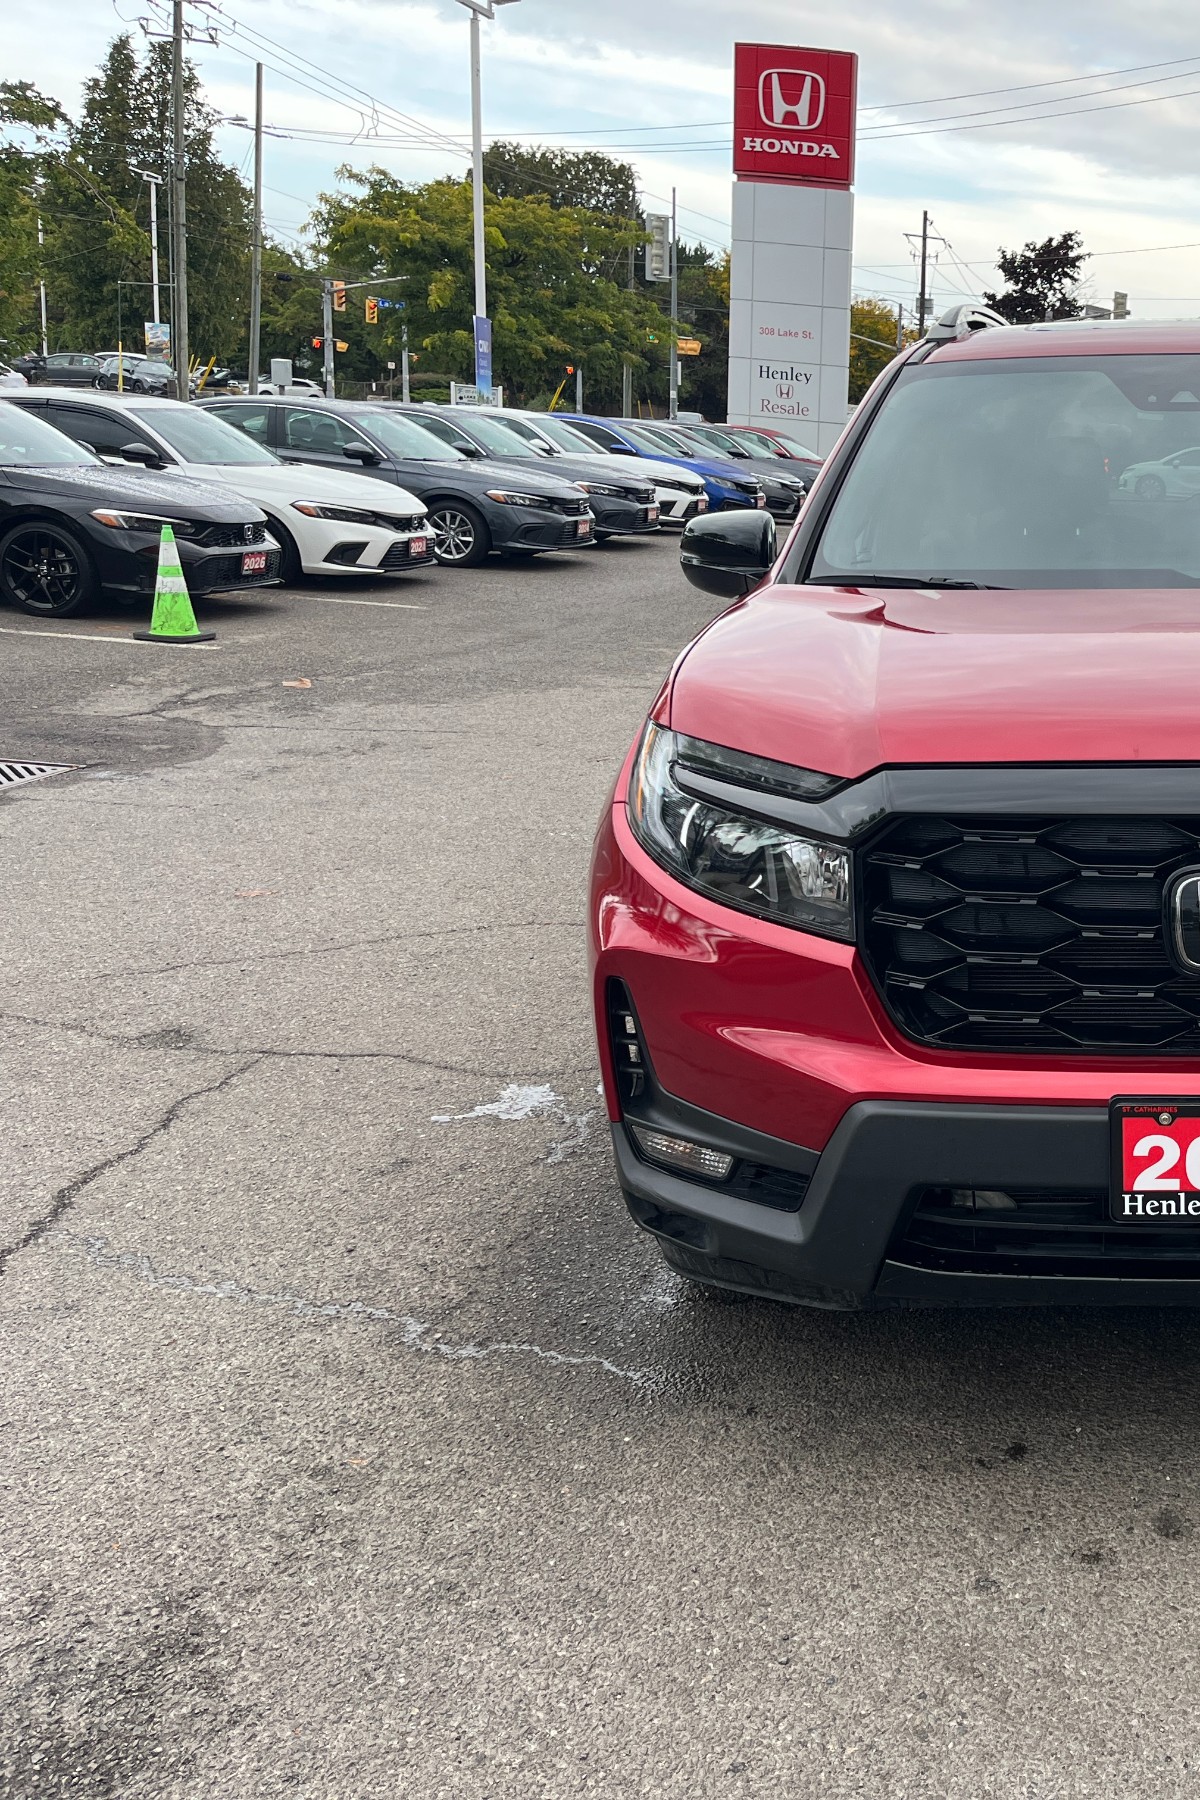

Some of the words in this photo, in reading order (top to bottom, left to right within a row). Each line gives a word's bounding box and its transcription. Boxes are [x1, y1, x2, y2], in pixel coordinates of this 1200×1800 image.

[742, 137, 840, 159] HONDA
[759, 327, 775, 336] 308
[778, 328, 799, 338] Lake
[802, 330, 815, 340] St.
[758, 364, 813, 385] Henley
[760, 398, 810, 417] Resale
[243, 556, 266, 570] 2026
